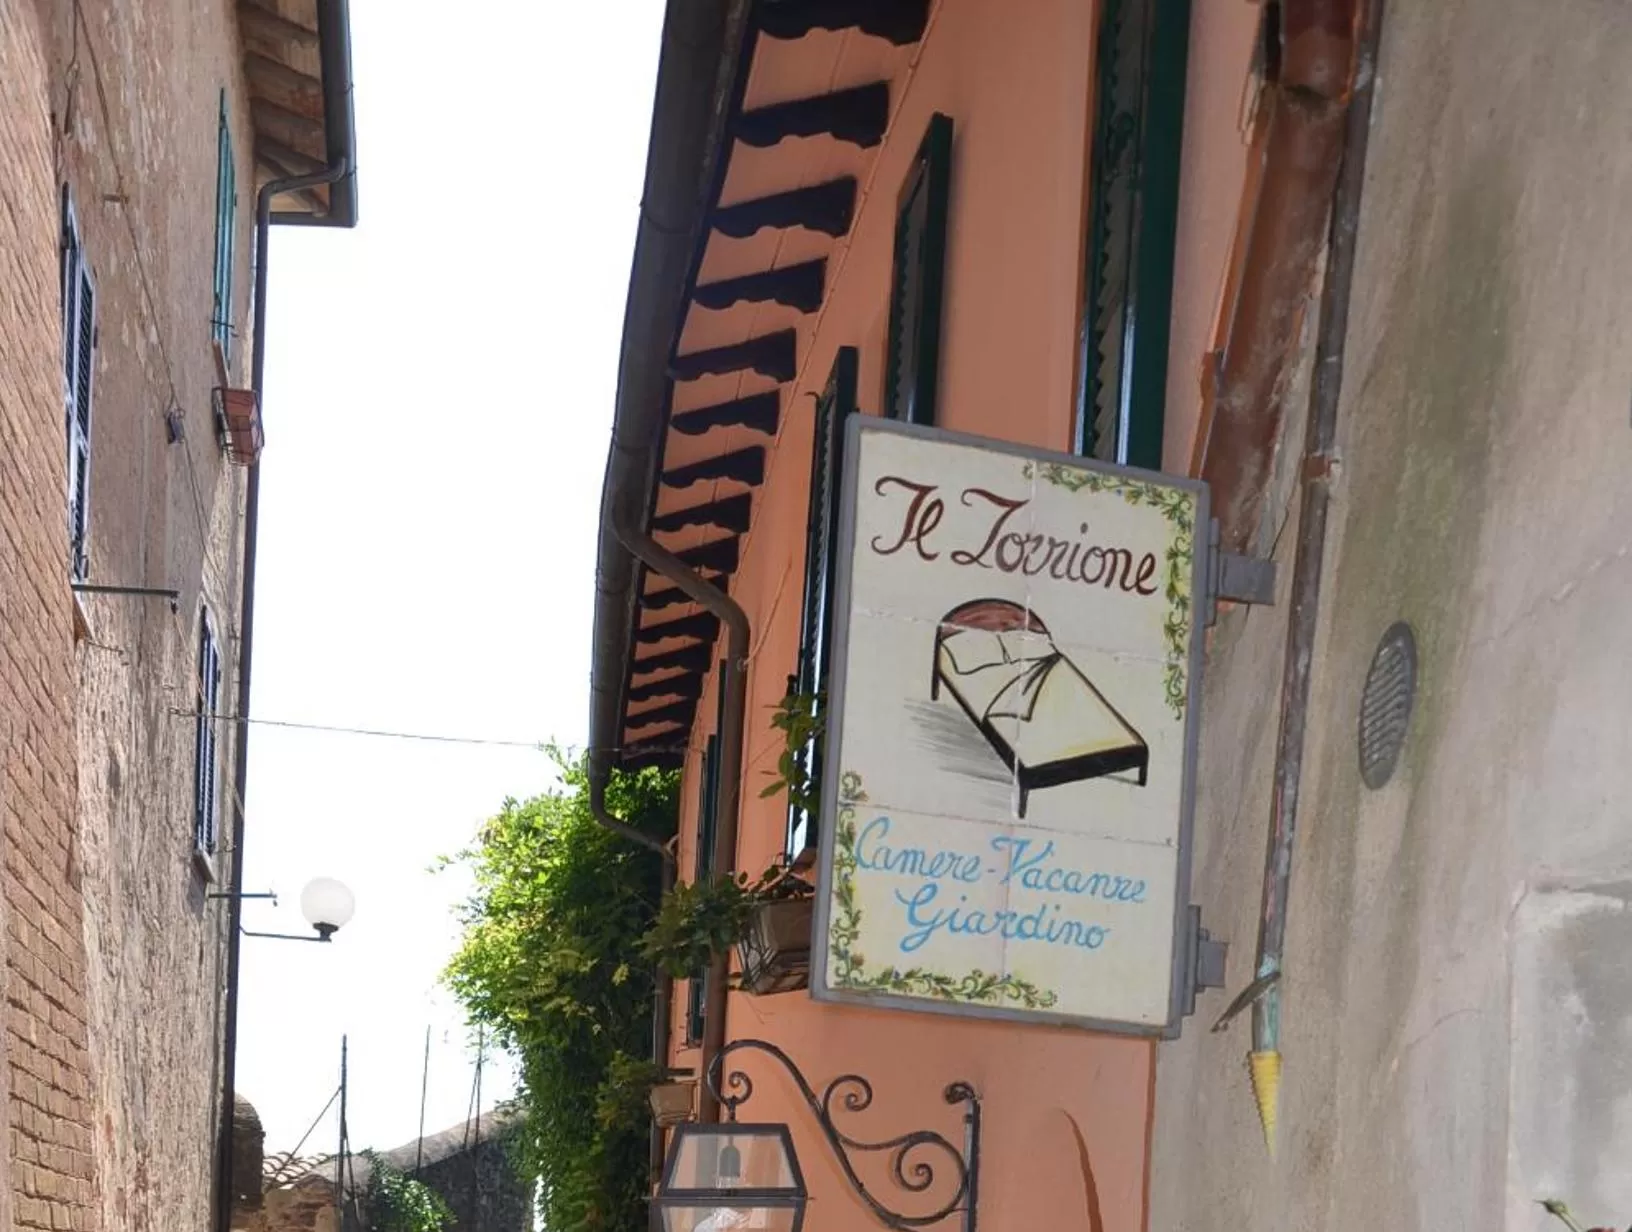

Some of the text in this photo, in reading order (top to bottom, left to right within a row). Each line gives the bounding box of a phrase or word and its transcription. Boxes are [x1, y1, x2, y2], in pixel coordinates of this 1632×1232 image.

[871, 476, 1158, 596] Il Torrione
[895, 883, 1109, 953] Giardino
